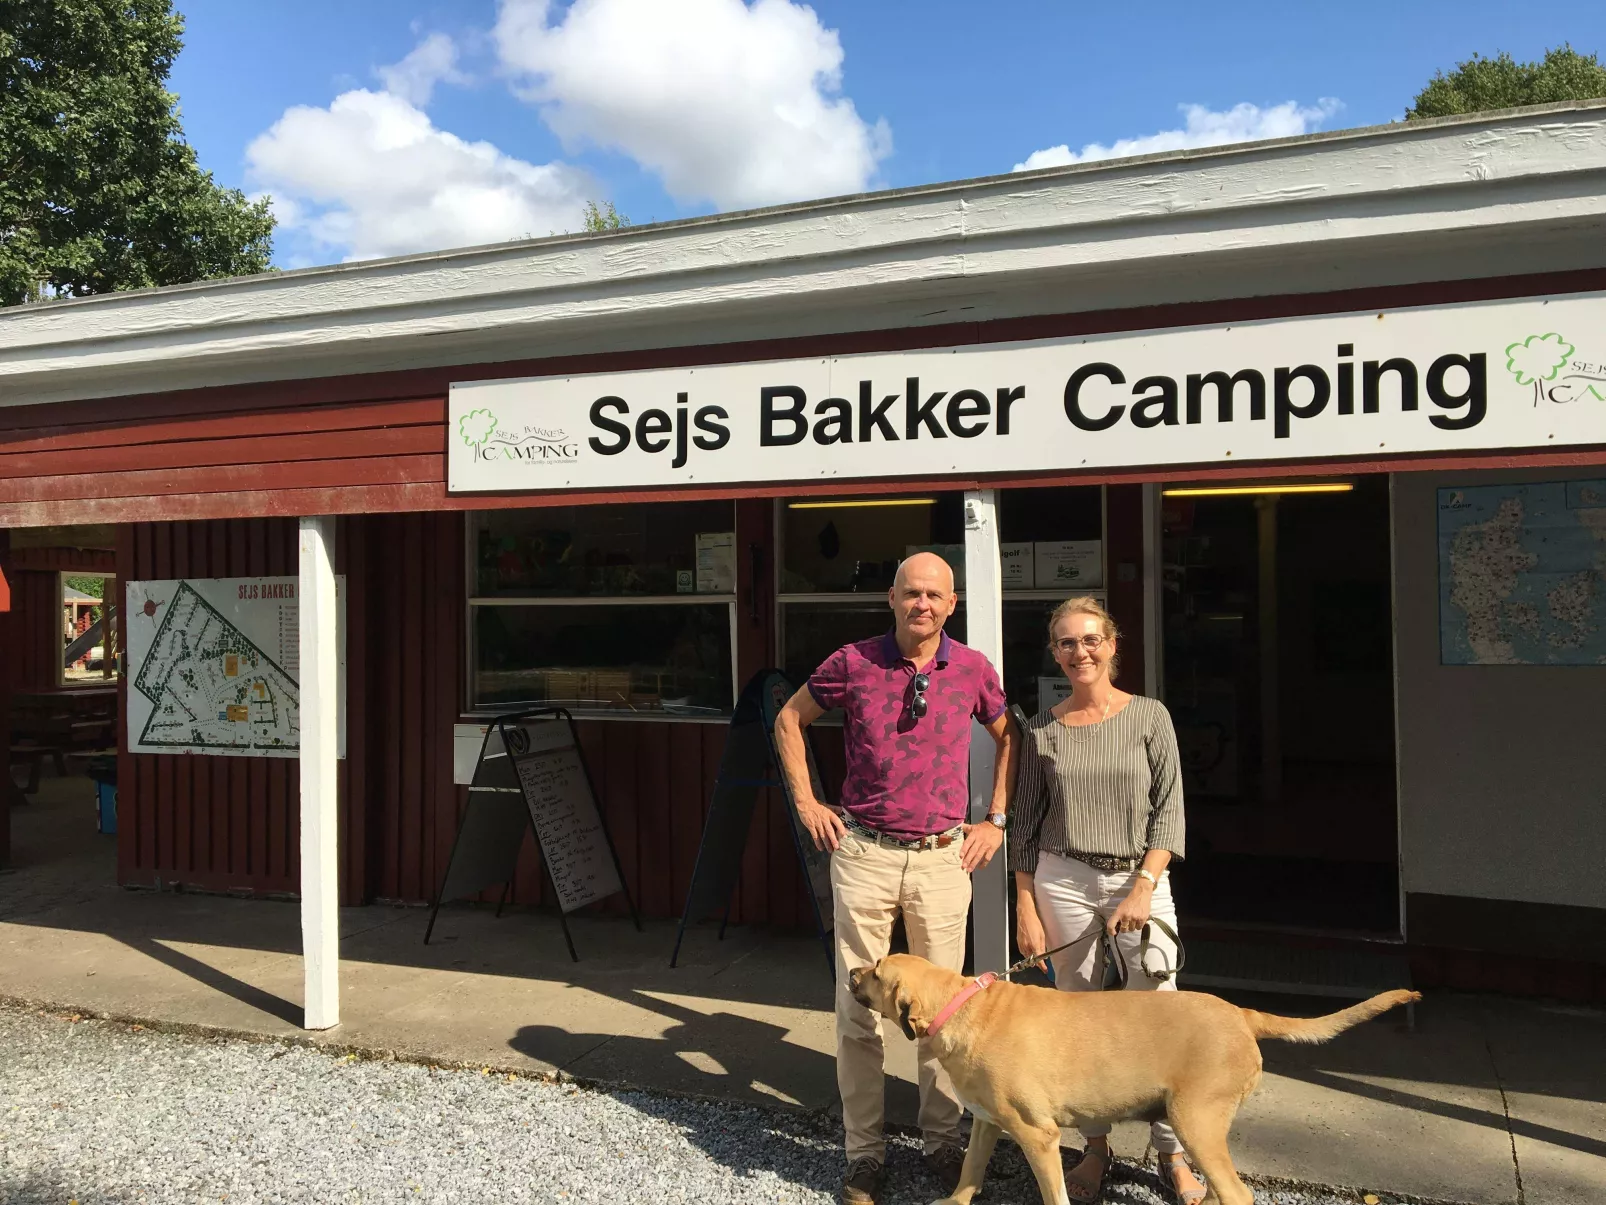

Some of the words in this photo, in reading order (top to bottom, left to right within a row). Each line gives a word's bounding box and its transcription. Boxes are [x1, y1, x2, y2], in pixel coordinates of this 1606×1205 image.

[1548, 383, 1606, 404] CA
[588, 391, 731, 469] Sejs
[760, 376, 1025, 448] Bakker
[1063, 343, 1488, 438] Camping
[495, 429, 519, 441] SEJS
[523, 425, 566, 438] BAKKER
[482, 443, 578, 461] CAMPING
[1001, 549, 1020, 559] igolf
[238, 584, 258, 600] SEJS
[261, 583, 295, 599] BAKKER
